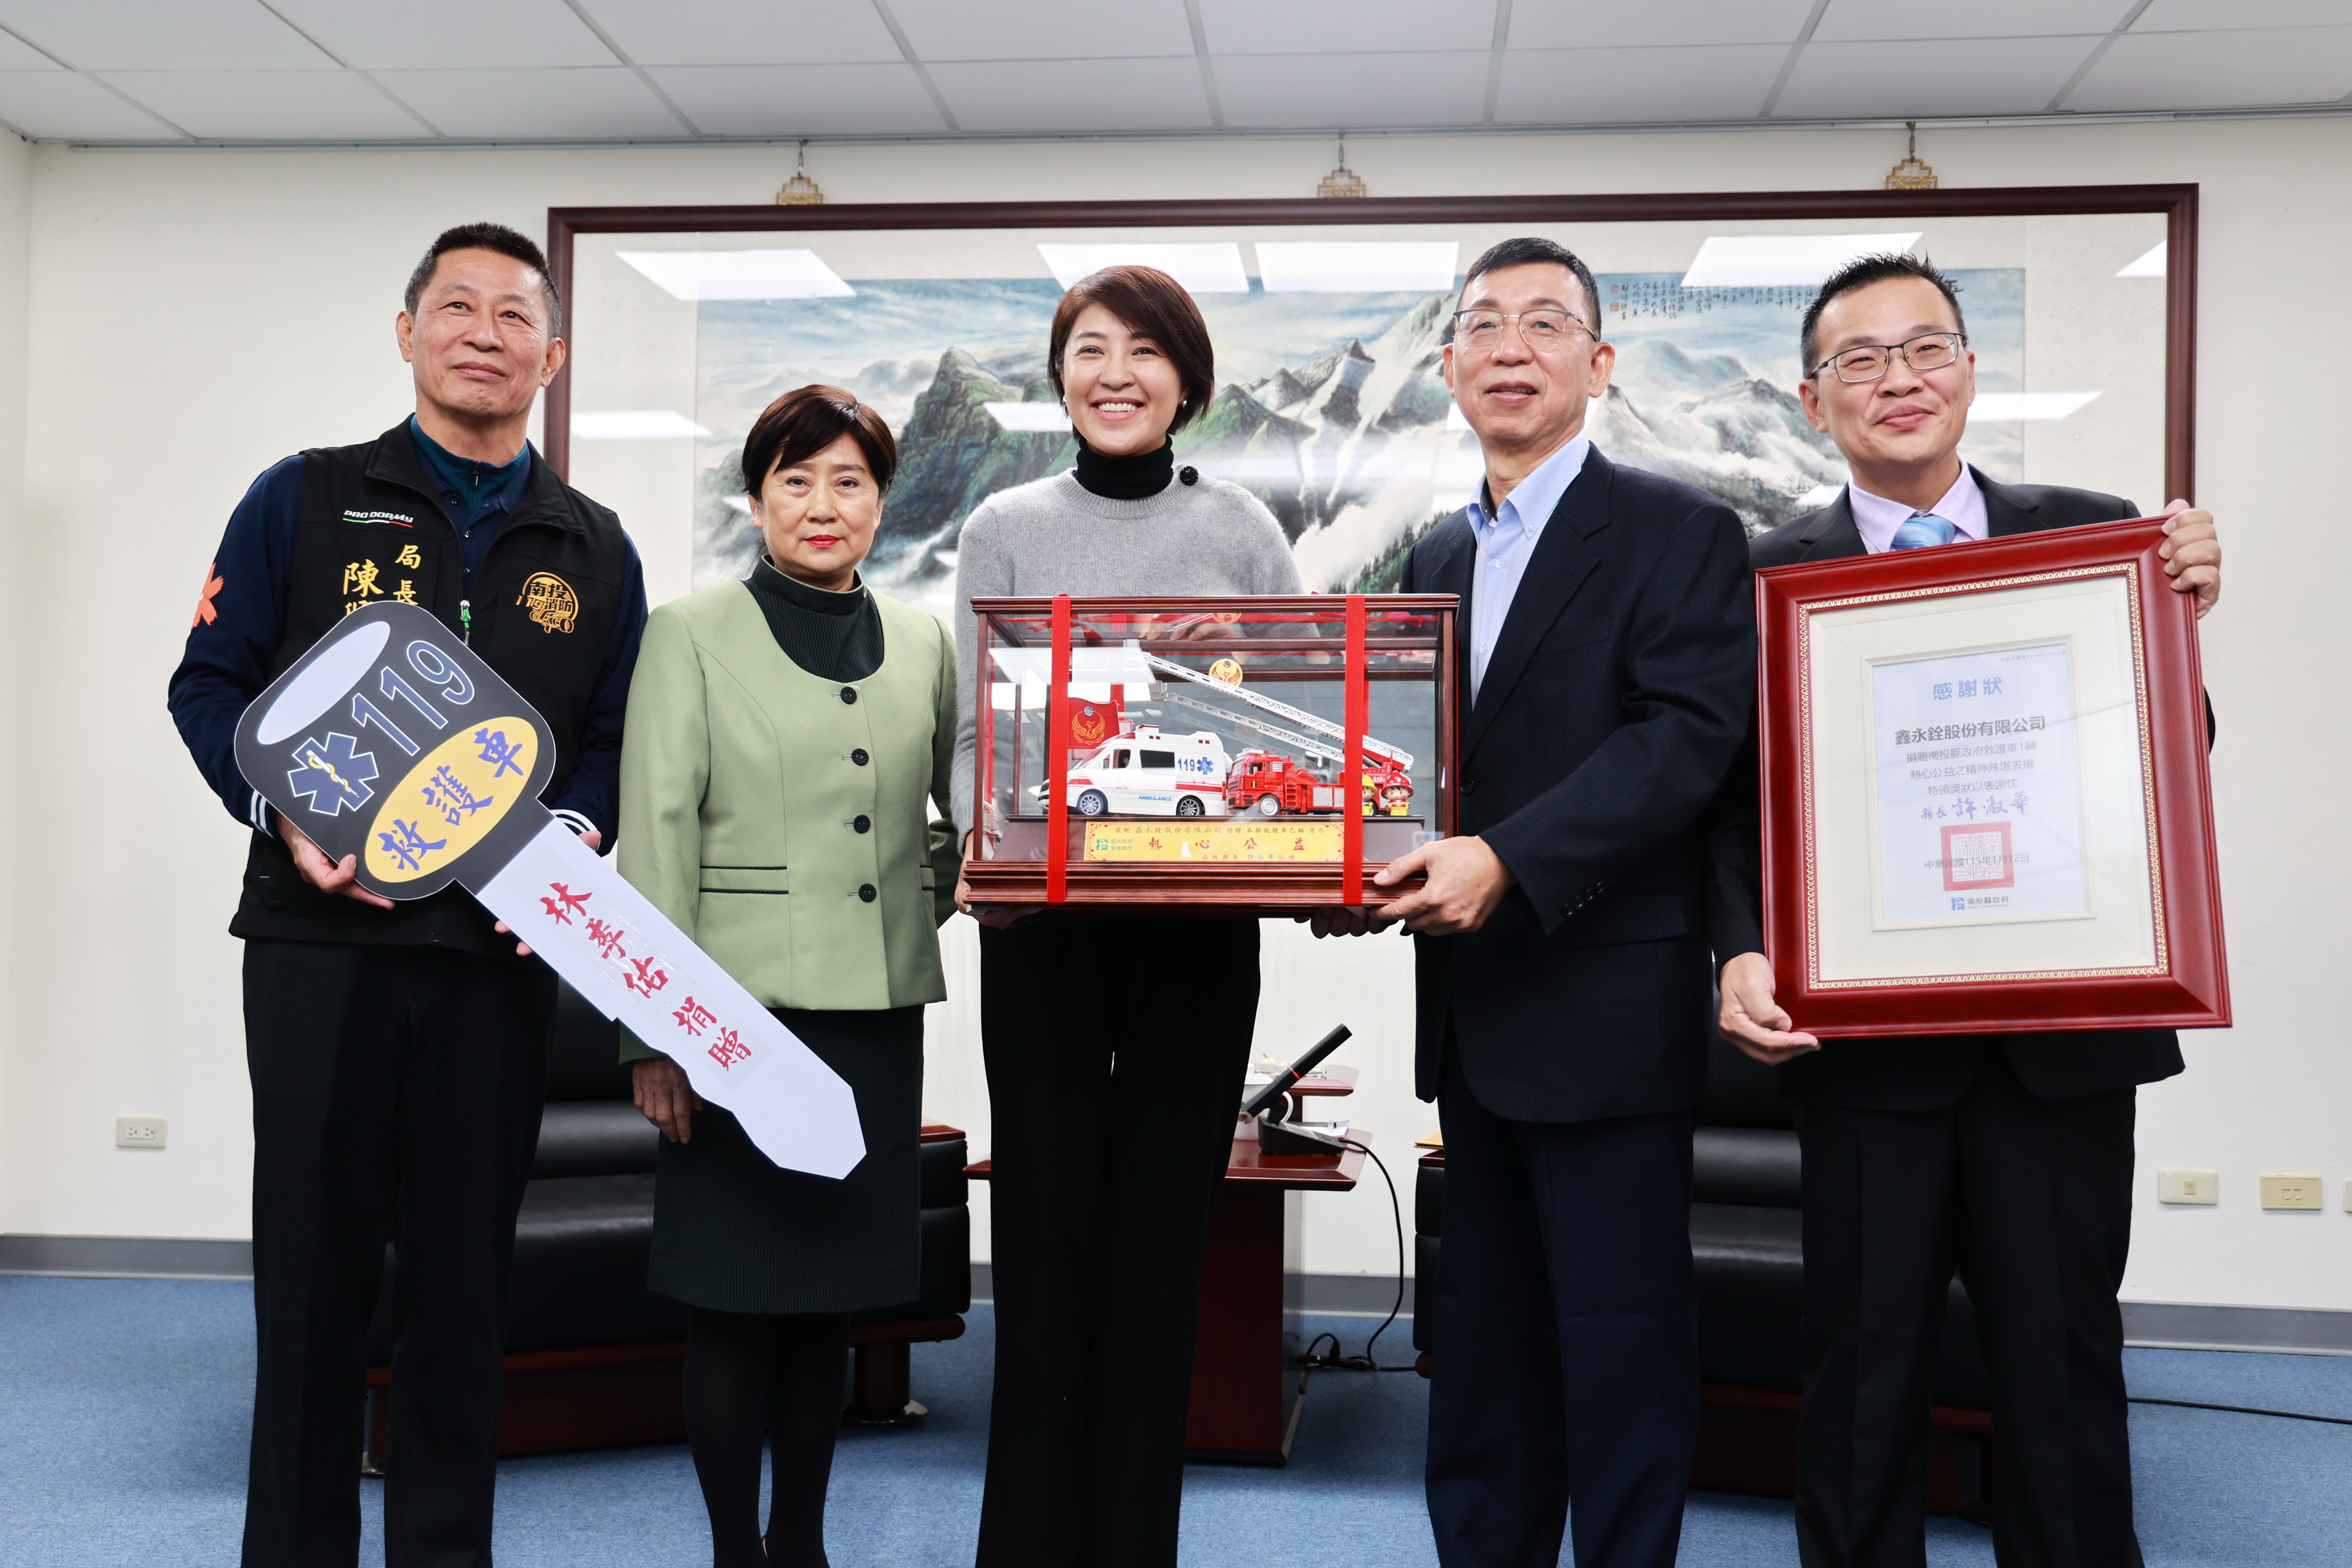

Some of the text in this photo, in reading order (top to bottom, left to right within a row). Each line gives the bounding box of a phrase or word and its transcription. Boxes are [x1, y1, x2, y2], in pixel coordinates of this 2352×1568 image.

[344, 510, 368, 518] PRO
[393, 544, 421, 605] 局長
[530, 582, 567, 599] 南投
[546, 598, 573, 612] 消防
[352, 640, 475, 757] 119
[1933, 677, 2003, 701] 感謝狀
[1895, 716, 2045, 745] 鑫永銓股份有限公司
[1906, 741, 2037, 763] 捐贈南投縣政府救護車1輛
[1178, 758, 1195, 772] 119
[1910, 759, 2034, 781] 熱心公益之精神殊堪表揚
[1927, 778, 2019, 796] 特頒獎狀以表謝忱
[378, 727, 524, 871] 救護車
[1148, 837, 1304, 850] 熱心公益
[1968, 896, 2009, 905] 南投縣政府
[539, 882, 752, 1072] 林季佑 捐贈
